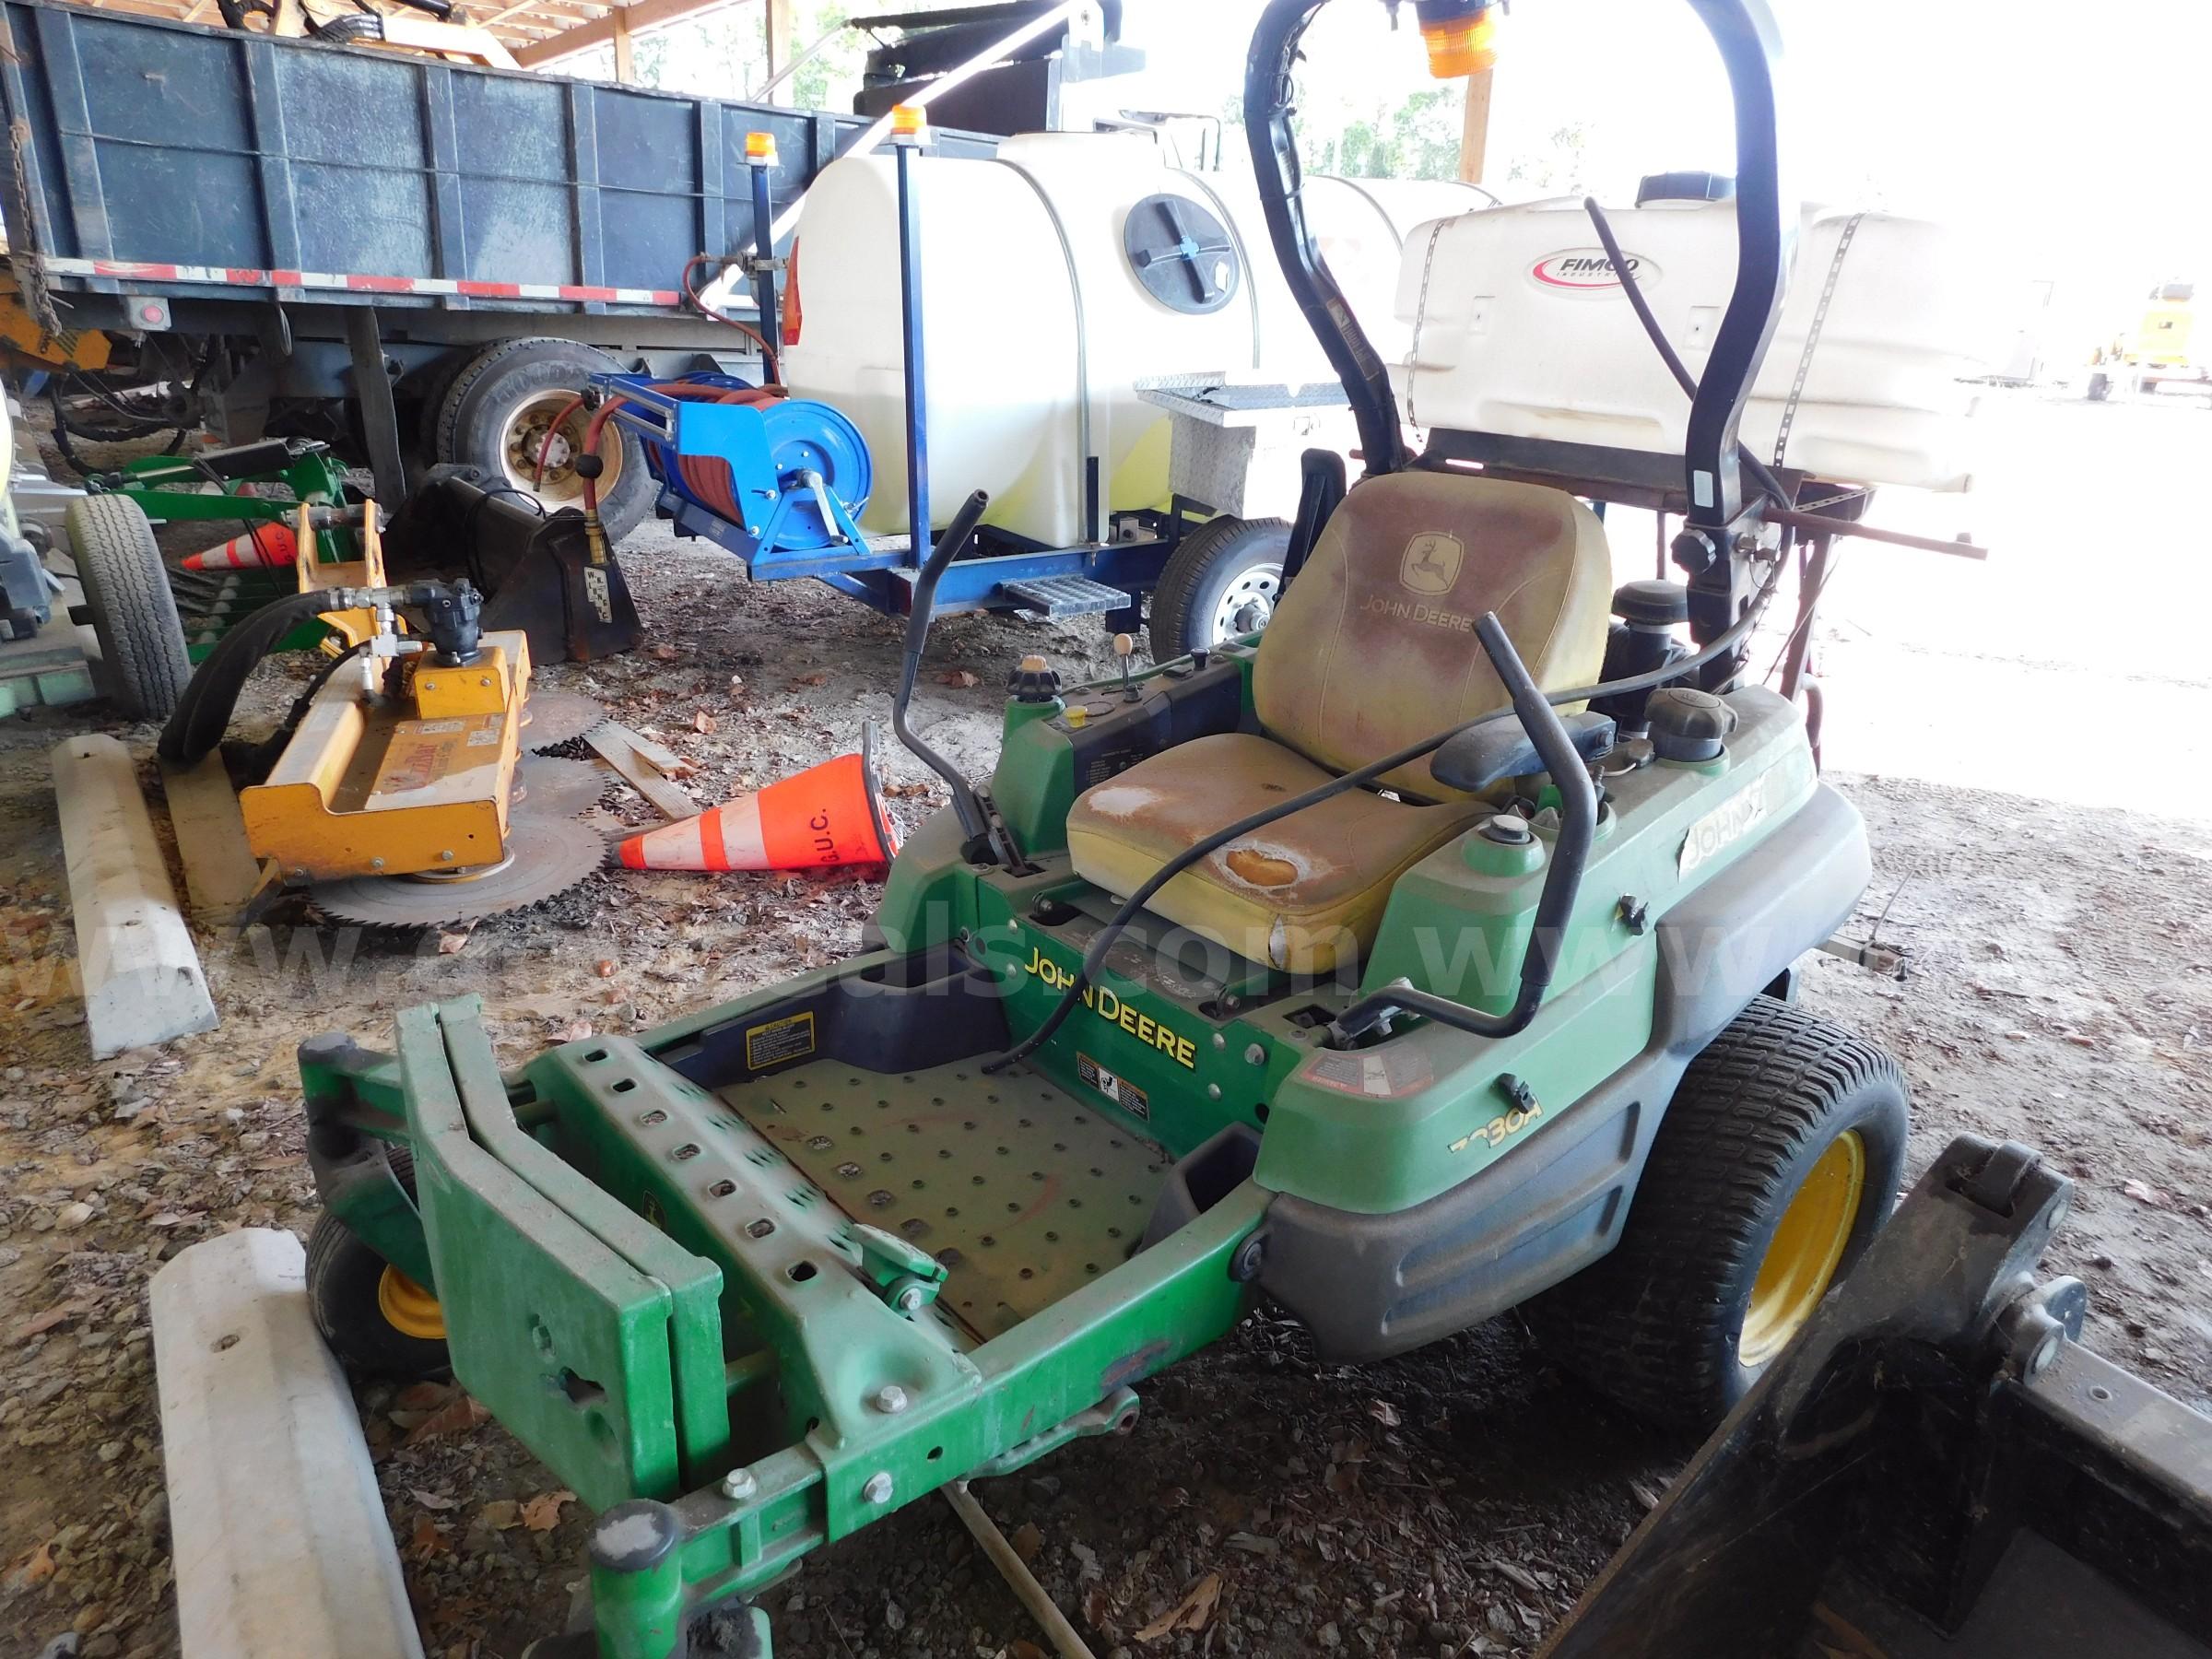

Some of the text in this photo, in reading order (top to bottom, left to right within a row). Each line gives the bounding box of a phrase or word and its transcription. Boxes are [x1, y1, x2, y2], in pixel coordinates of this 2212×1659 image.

[1359, 594, 1475, 633] JOHN DEERE
[1024, 947, 1195, 1069] JOHN DEERE
